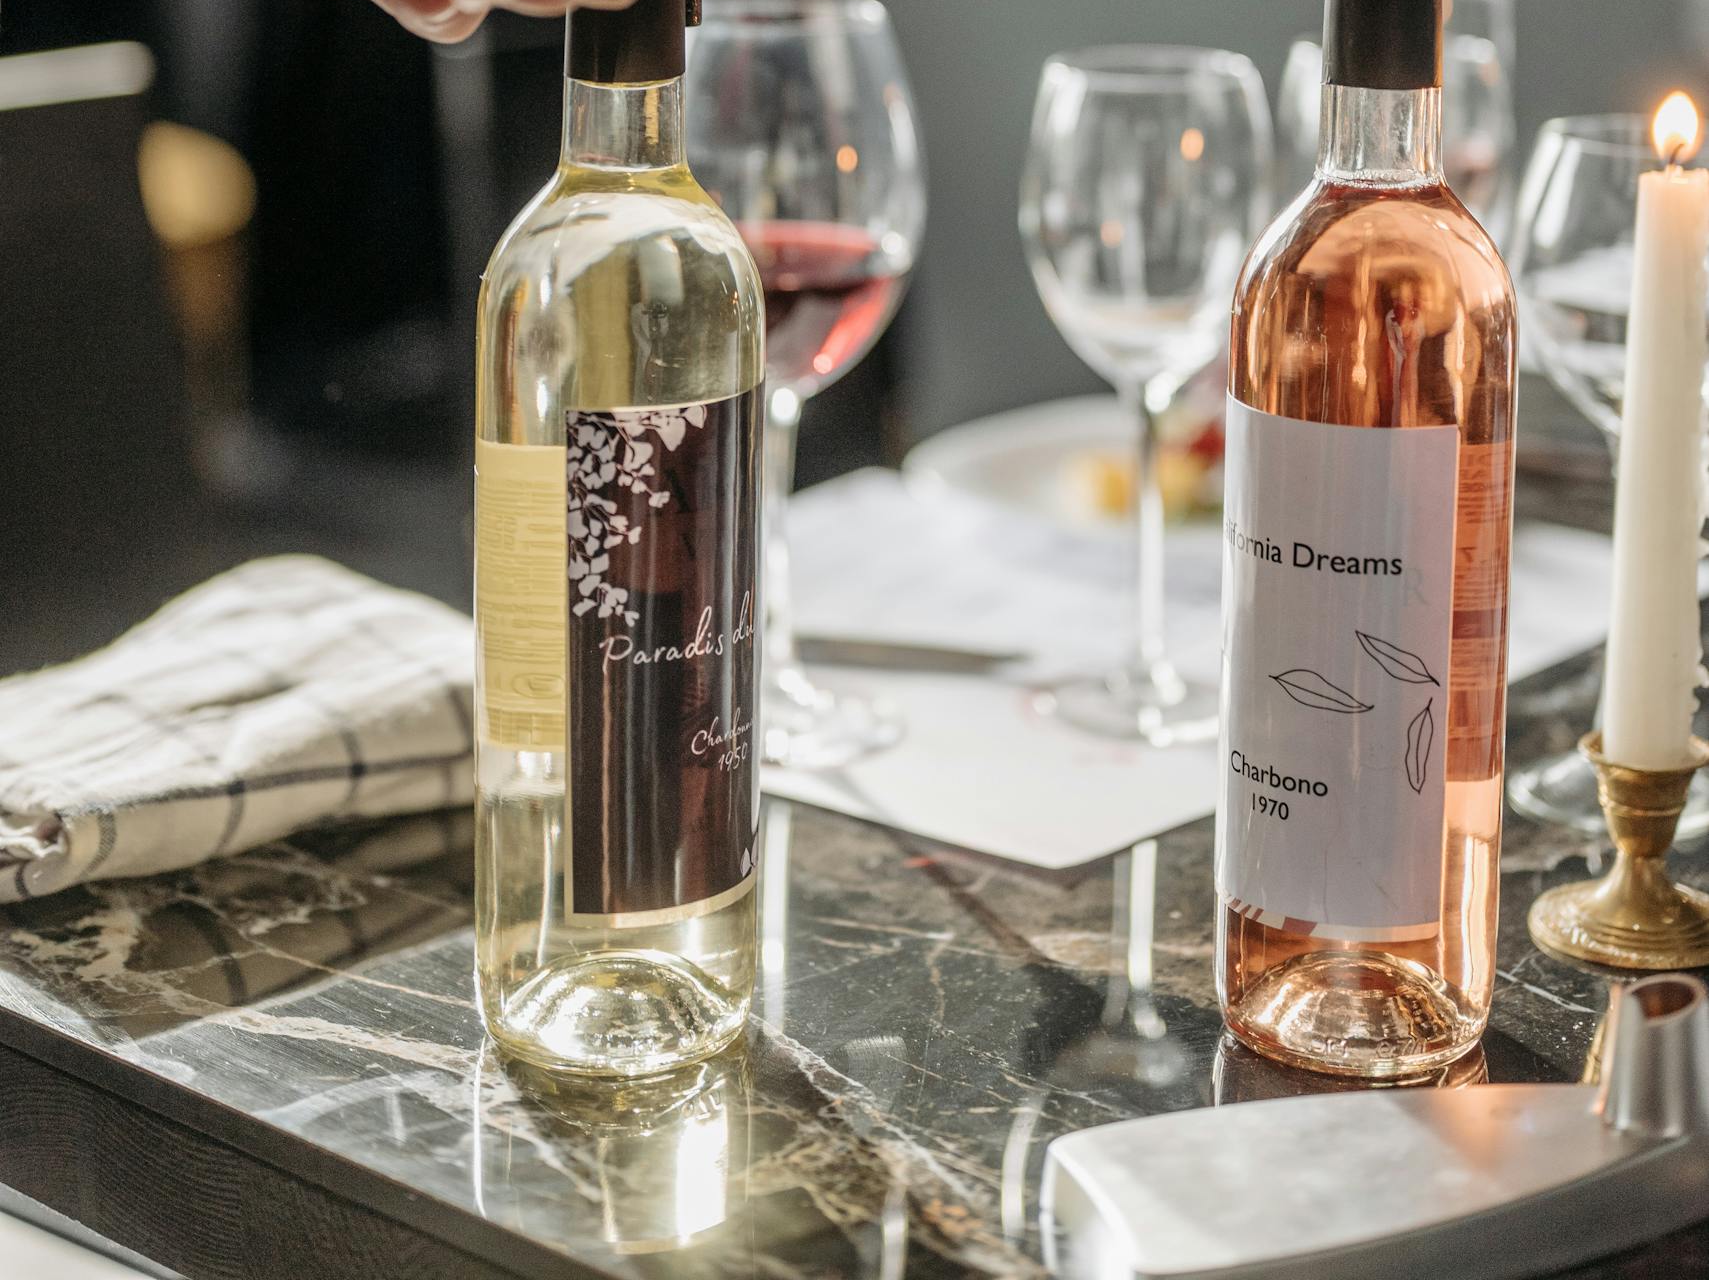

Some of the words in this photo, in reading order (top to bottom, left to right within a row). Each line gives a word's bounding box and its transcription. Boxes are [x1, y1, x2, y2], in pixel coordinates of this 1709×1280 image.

[1292, 542, 1403, 576] Dreams
[599, 606, 724, 674] Paradis
[718, 741, 748, 772] 1950
[1231, 750, 1328, 797] Charbono
[1252, 793, 1289, 821] 1970
